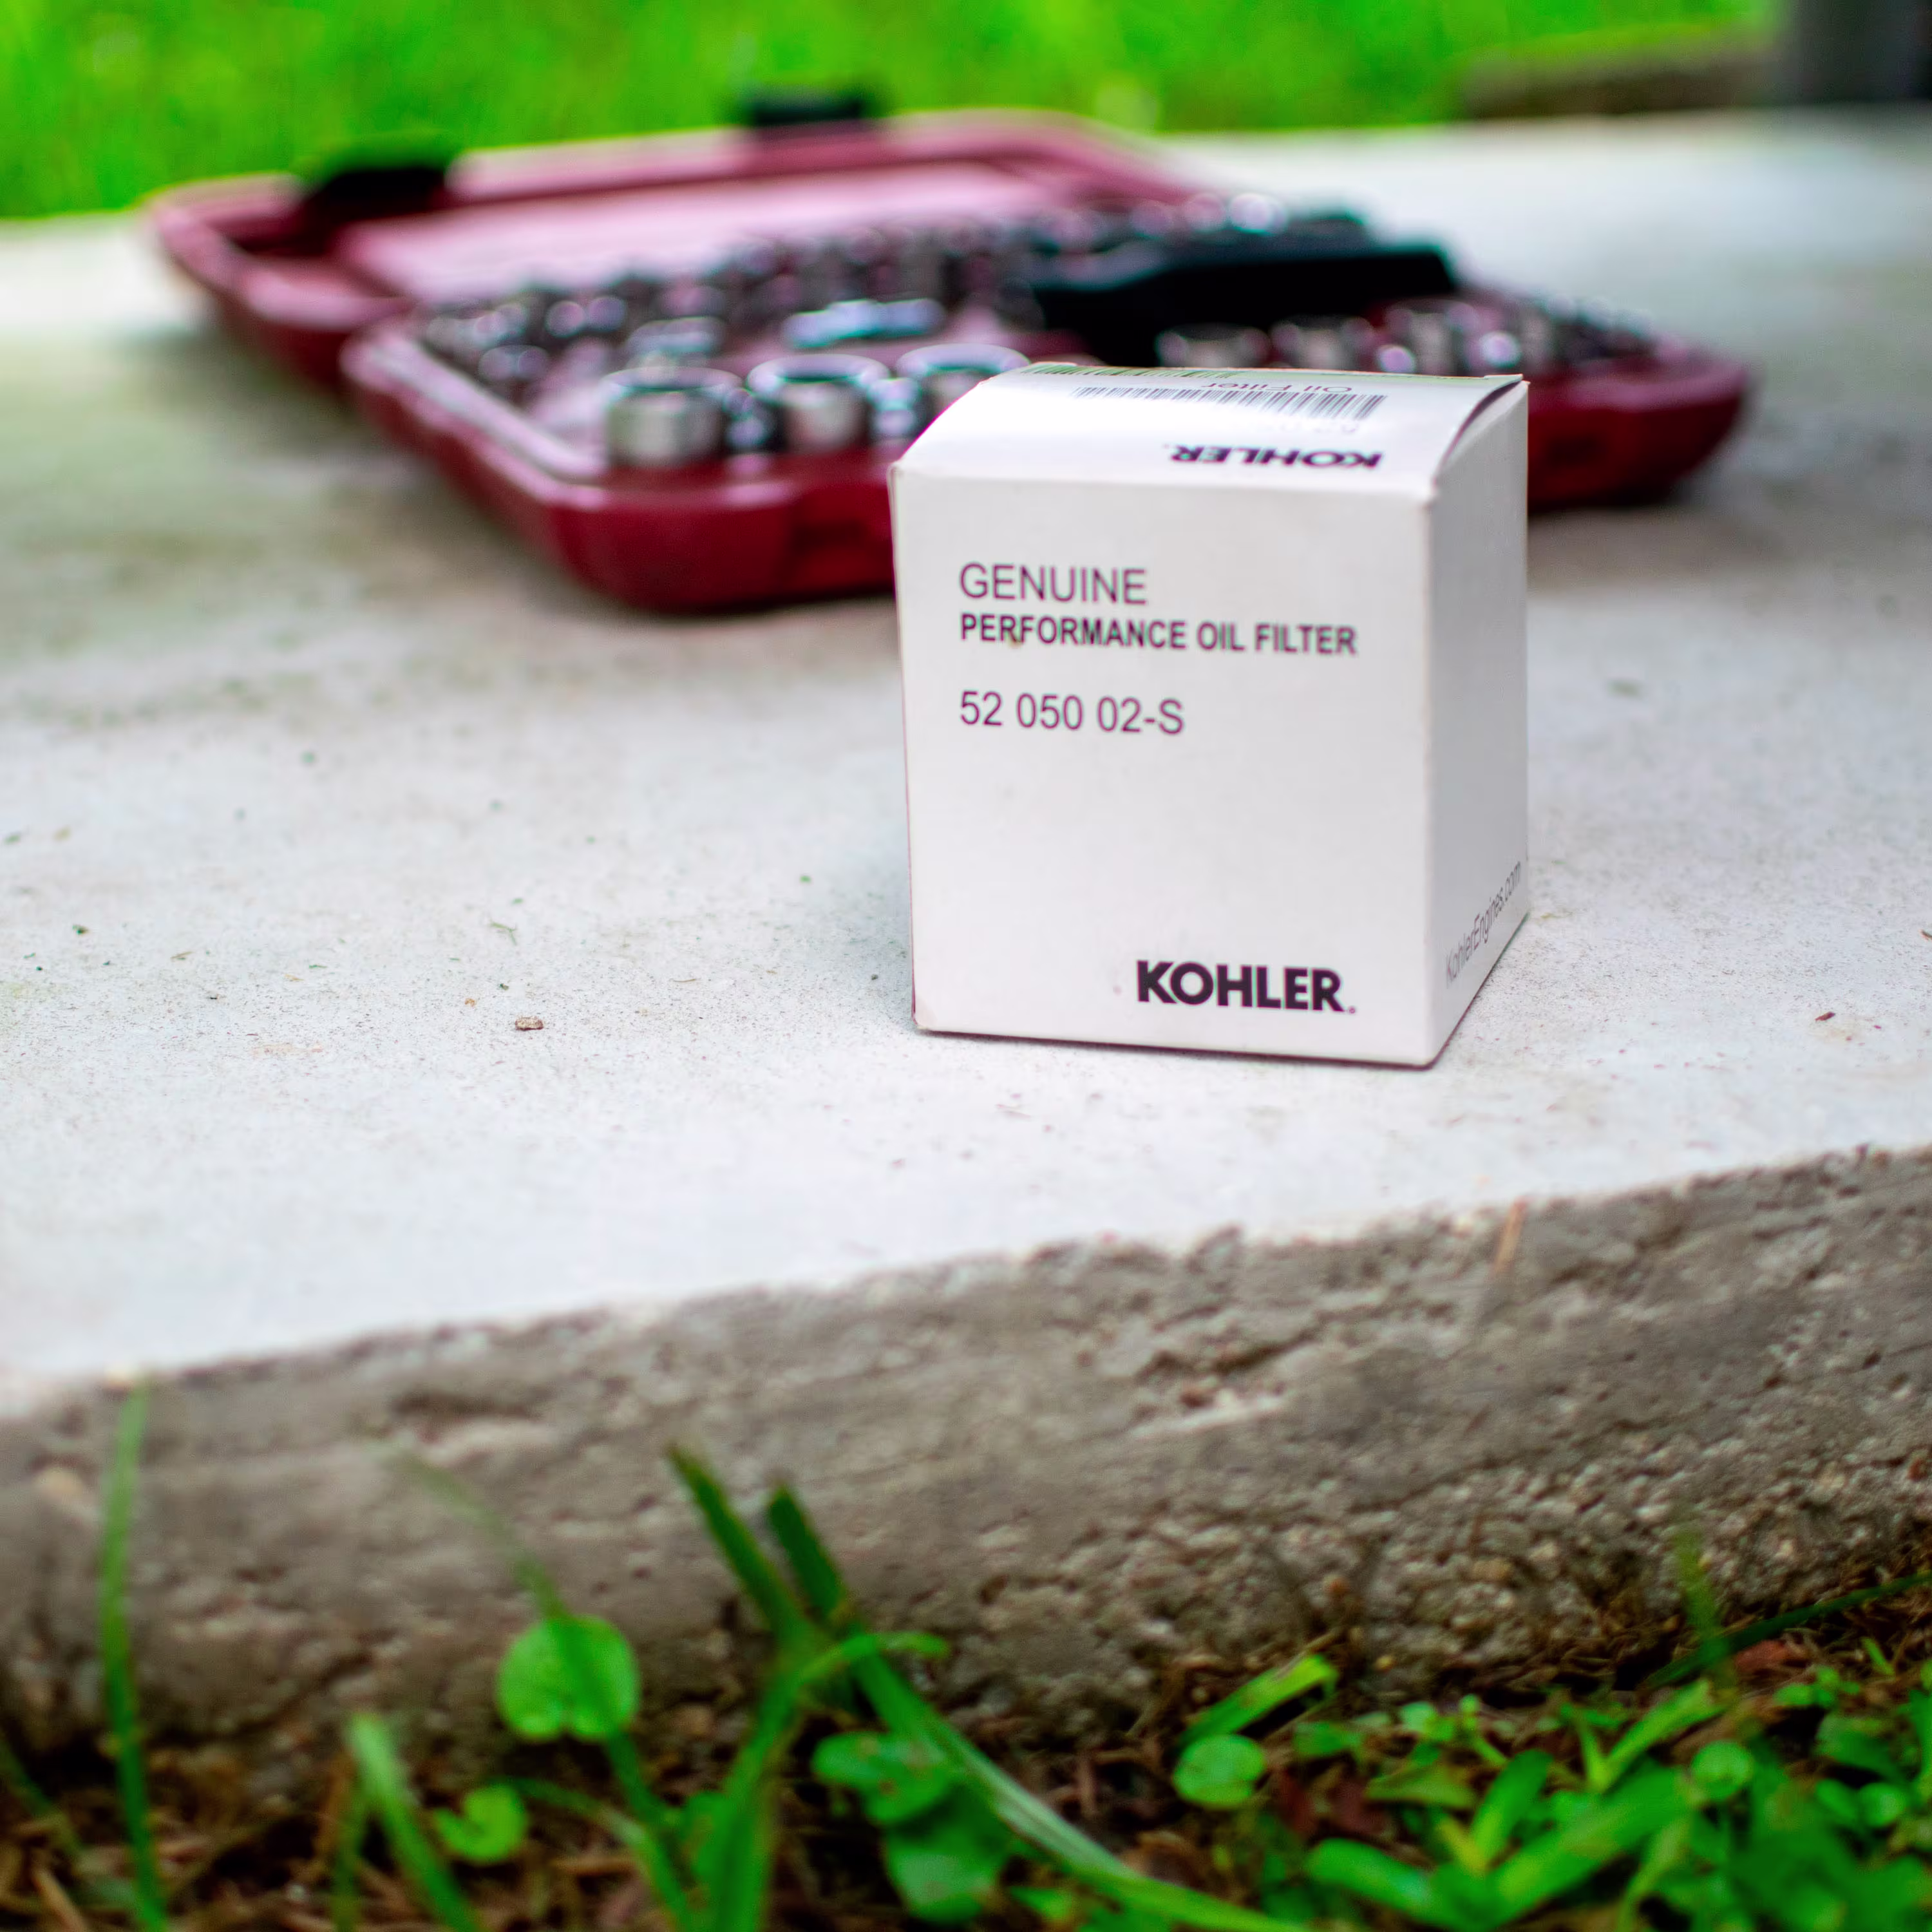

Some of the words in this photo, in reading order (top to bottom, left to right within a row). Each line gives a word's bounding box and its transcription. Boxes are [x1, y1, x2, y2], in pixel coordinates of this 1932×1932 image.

[1201, 382, 1293, 391] Filter
[1304, 384, 1352, 393] Oil
[1171, 444, 1383, 468] KOHLER
[960, 562, 1147, 605] GENUINE
[961, 613, 1186, 650] PERFORMANCE
[1197, 621, 1245, 652] OIL
[1255, 623, 1356, 655] FILTER
[960, 690, 1002, 726] 52
[1016, 693, 1083, 730] 050
[1097, 696, 1185, 735] 02-S
[1446, 860, 1520, 989] KohlerEngines.com
[1136, 960, 1346, 1012] KOHLER
